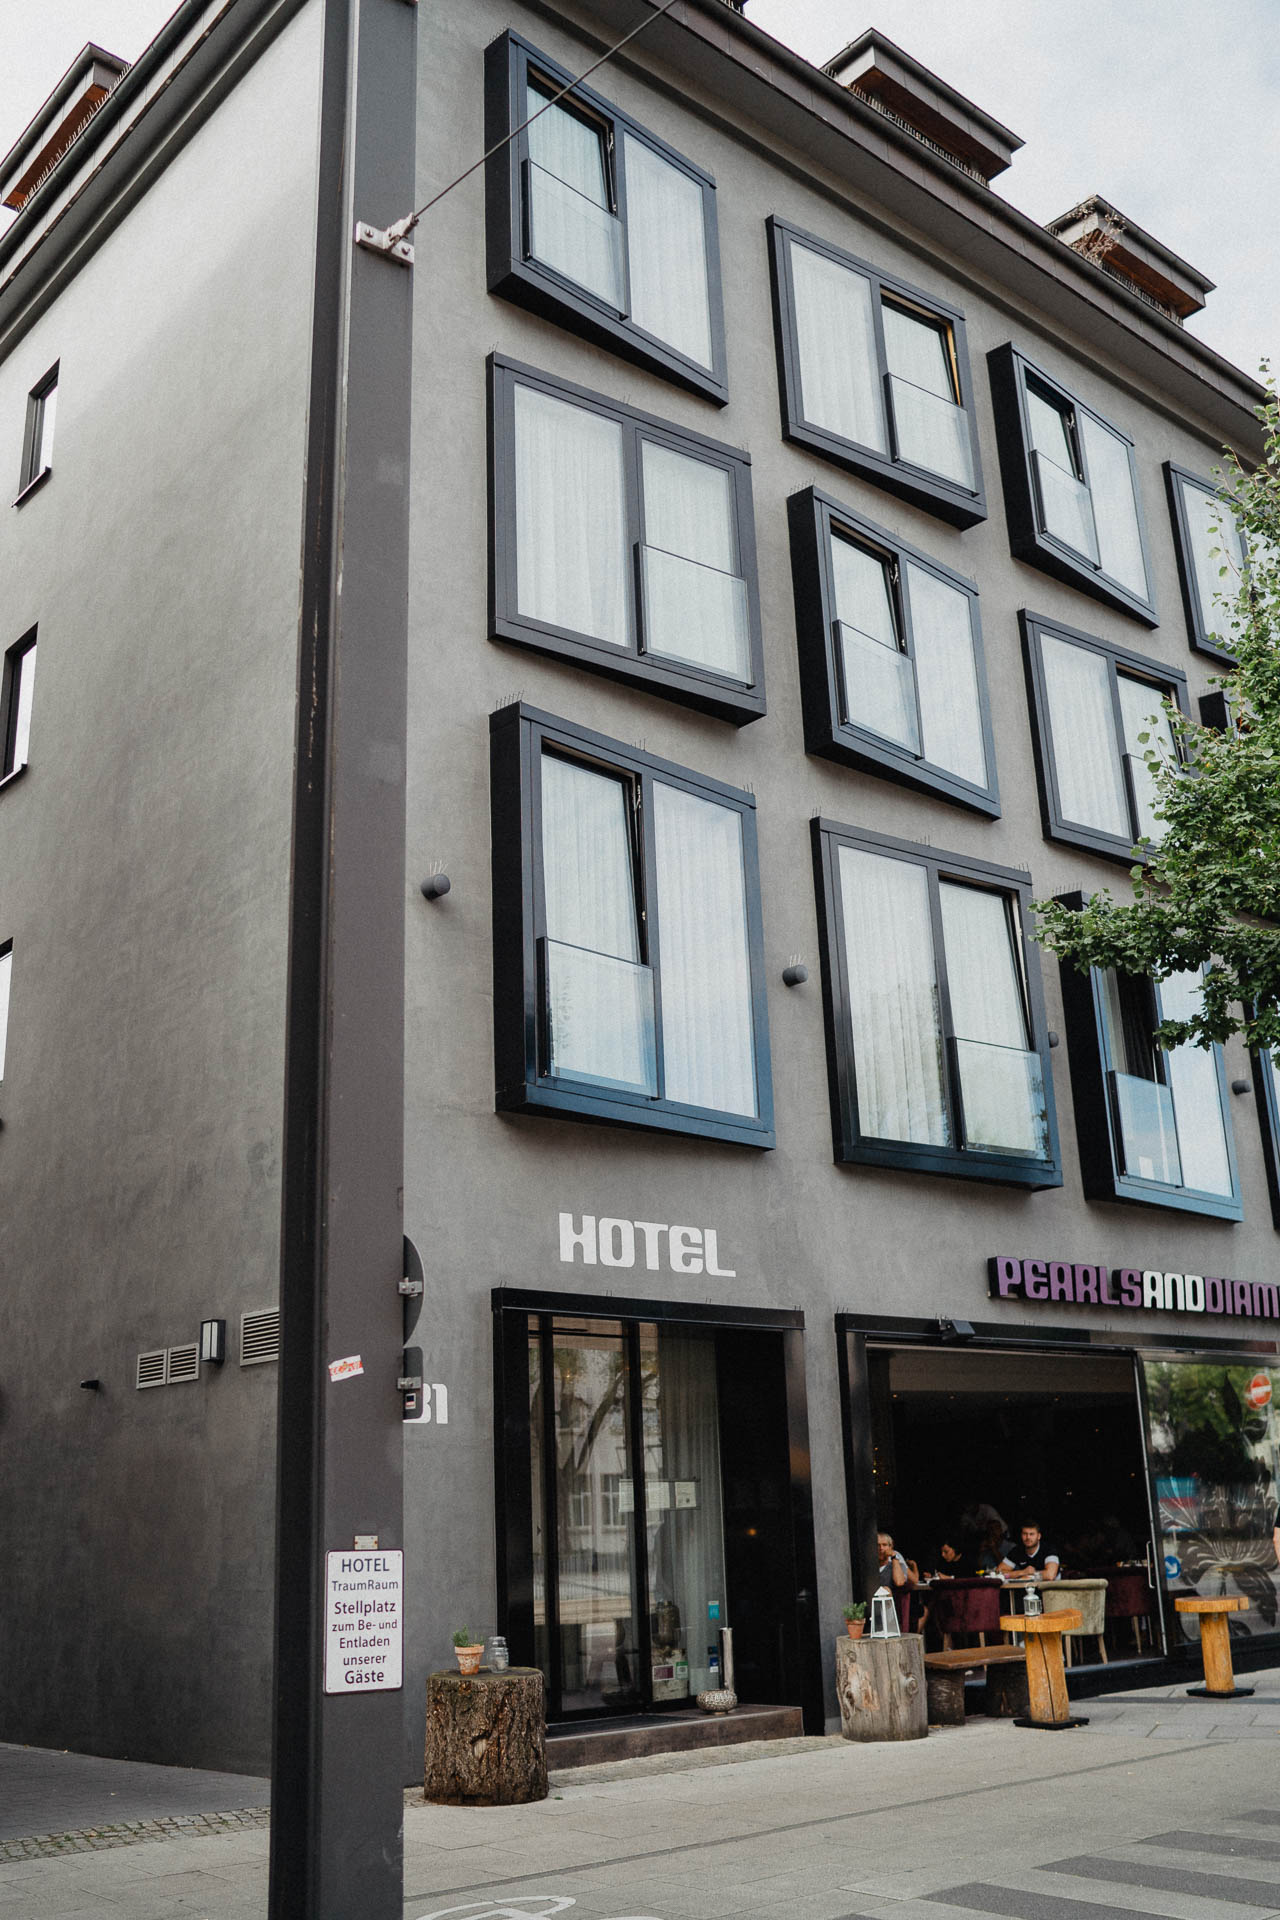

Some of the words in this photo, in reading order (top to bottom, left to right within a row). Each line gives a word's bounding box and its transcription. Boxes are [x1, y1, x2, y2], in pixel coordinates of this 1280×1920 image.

[559, 1212, 737, 1278] HOTEL
[341, 1557, 390, 1573] HOTEL
[332, 1579, 399, 1592] TraumRaum
[334, 1600, 396, 1617] Stellplatz
[332, 1623, 355, 1632] zum
[358, 1619, 377, 1631] Be-
[379, 1619, 398, 1630] und
[339, 1635, 390, 1649] Entladen
[343, 1654, 387, 1666] unserer
[344, 1670, 385, 1685] Gäste
